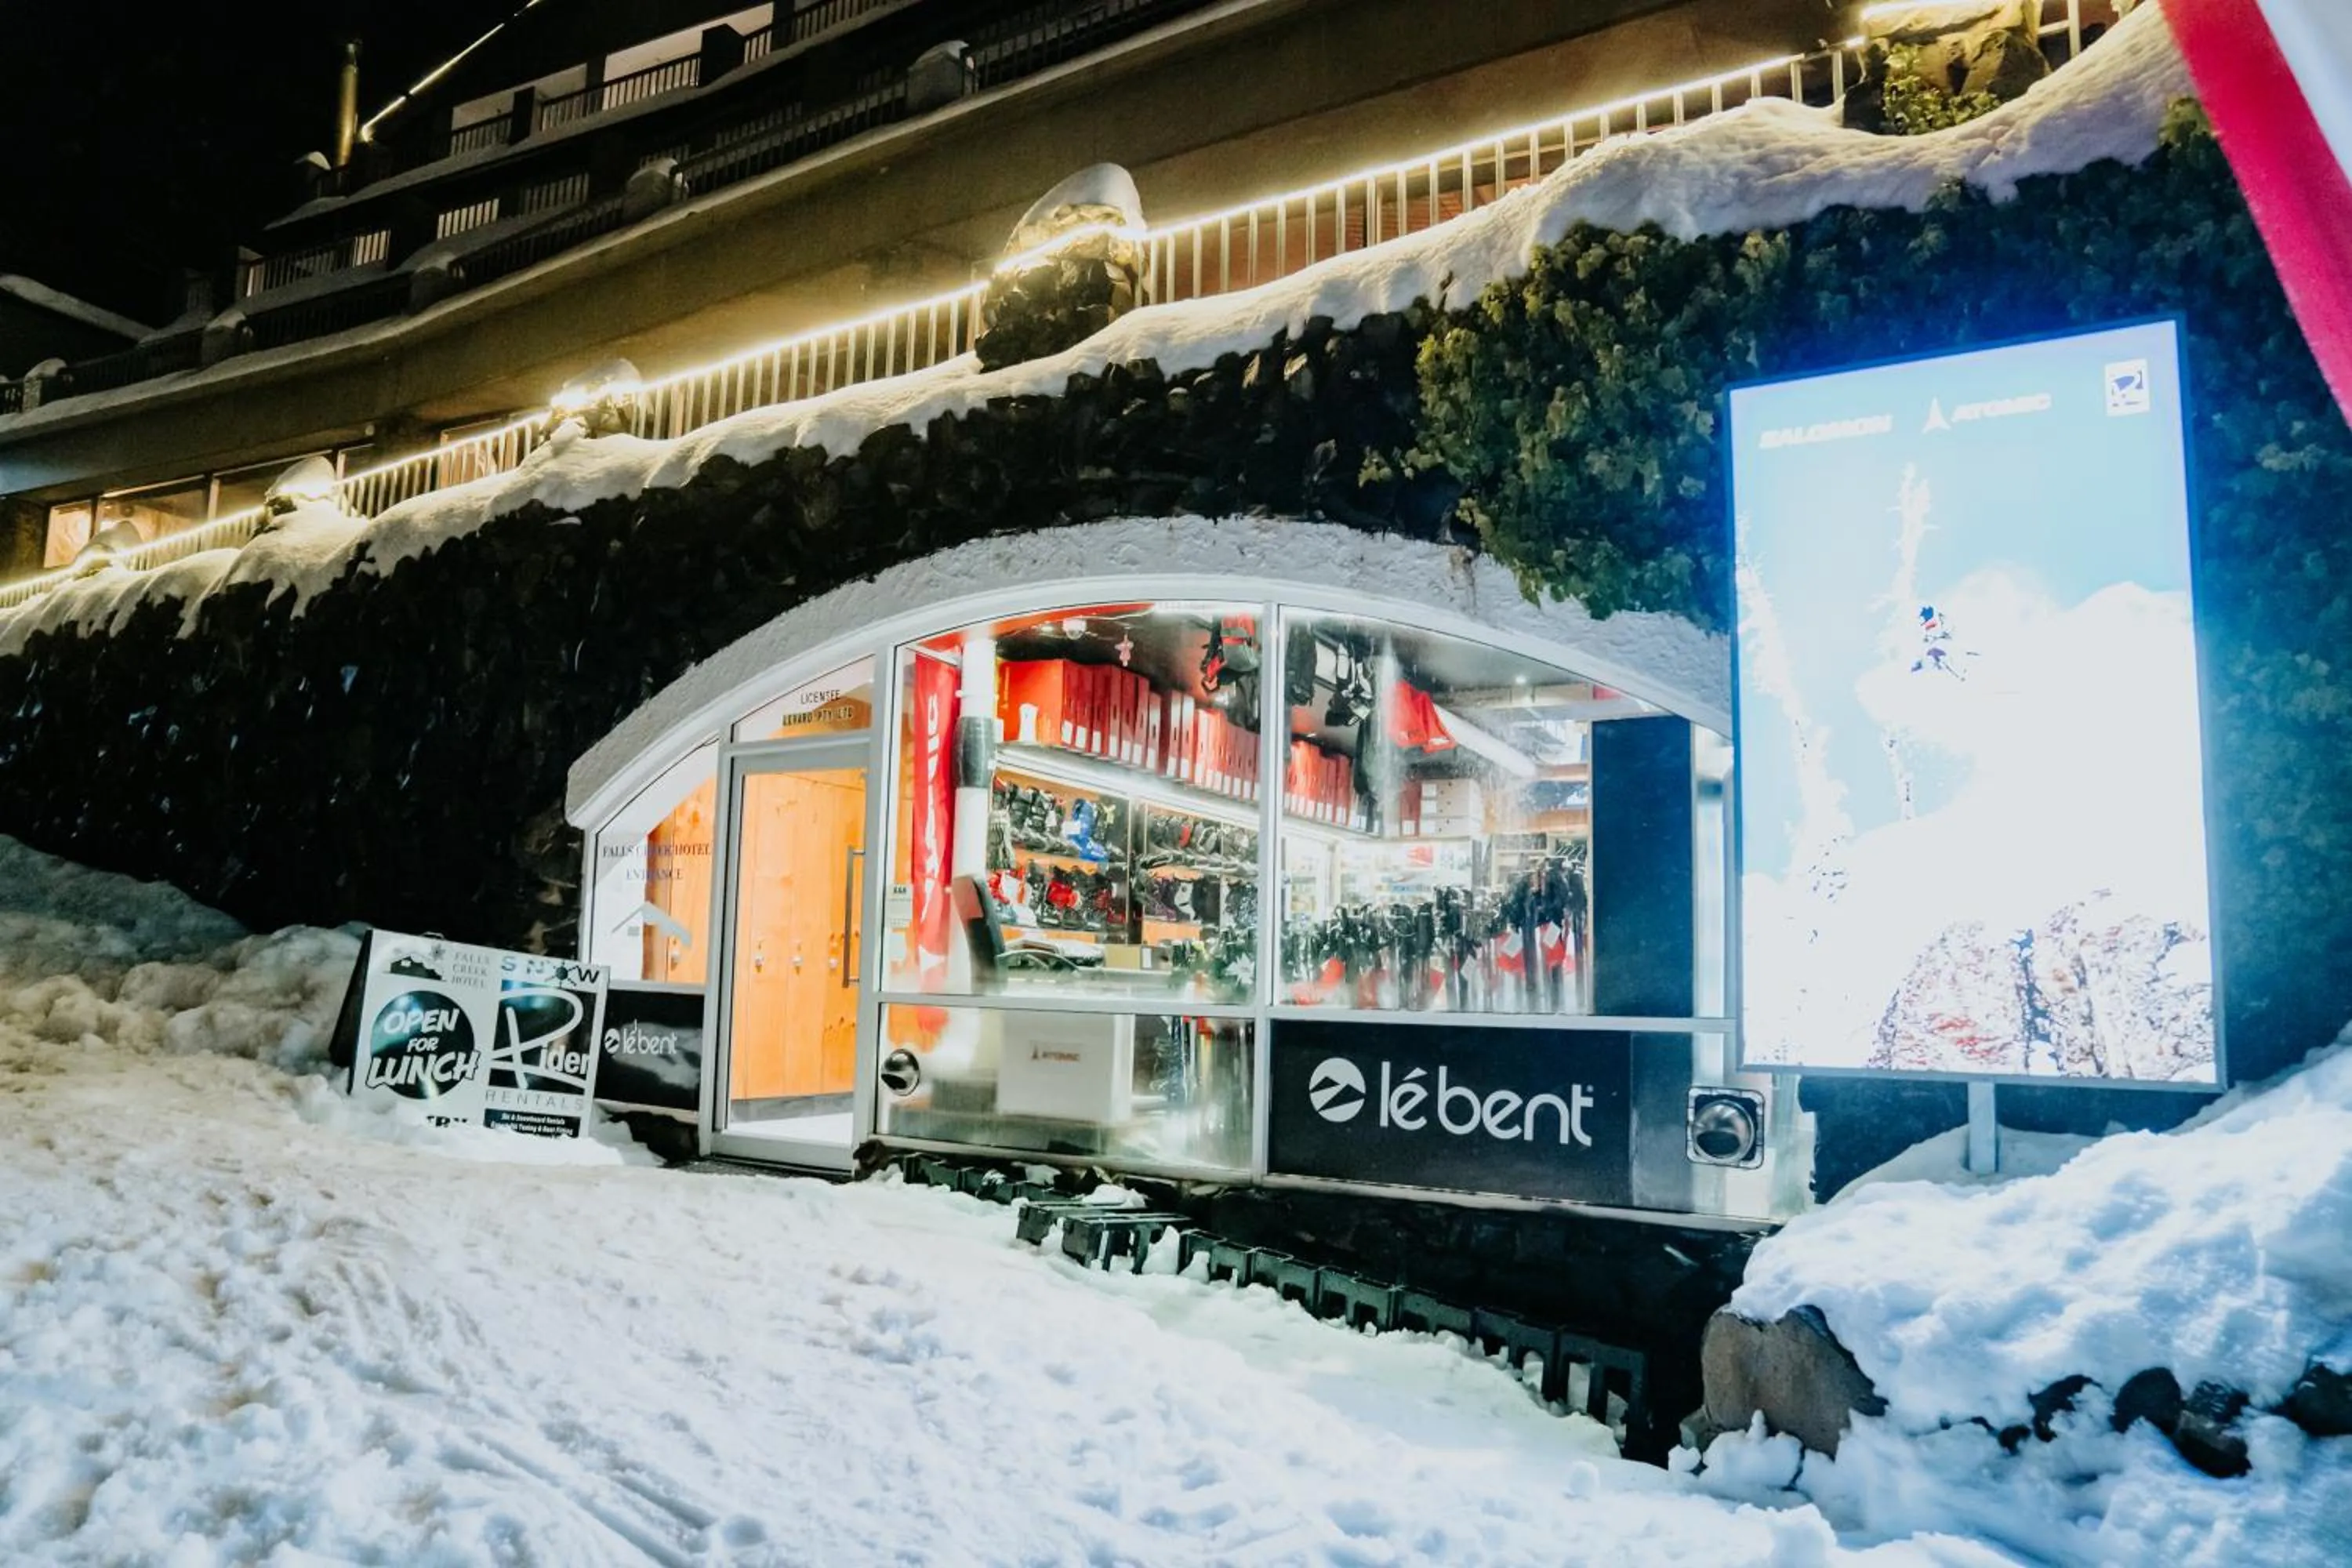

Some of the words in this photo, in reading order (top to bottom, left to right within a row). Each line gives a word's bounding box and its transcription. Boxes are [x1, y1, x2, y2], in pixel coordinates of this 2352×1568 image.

[800, 690, 841, 704] LICENSEE
[602, 844, 634, 858] FALLS
[675, 843, 712, 857] HOTEL
[452, 964, 488, 977] CREEK
[383, 1007, 460, 1034] OPEN
[407, 1036, 439, 1053] FOR
[366, 1050, 481, 1089] LUNCH
[485, 1089, 584, 1112] RENTALS
